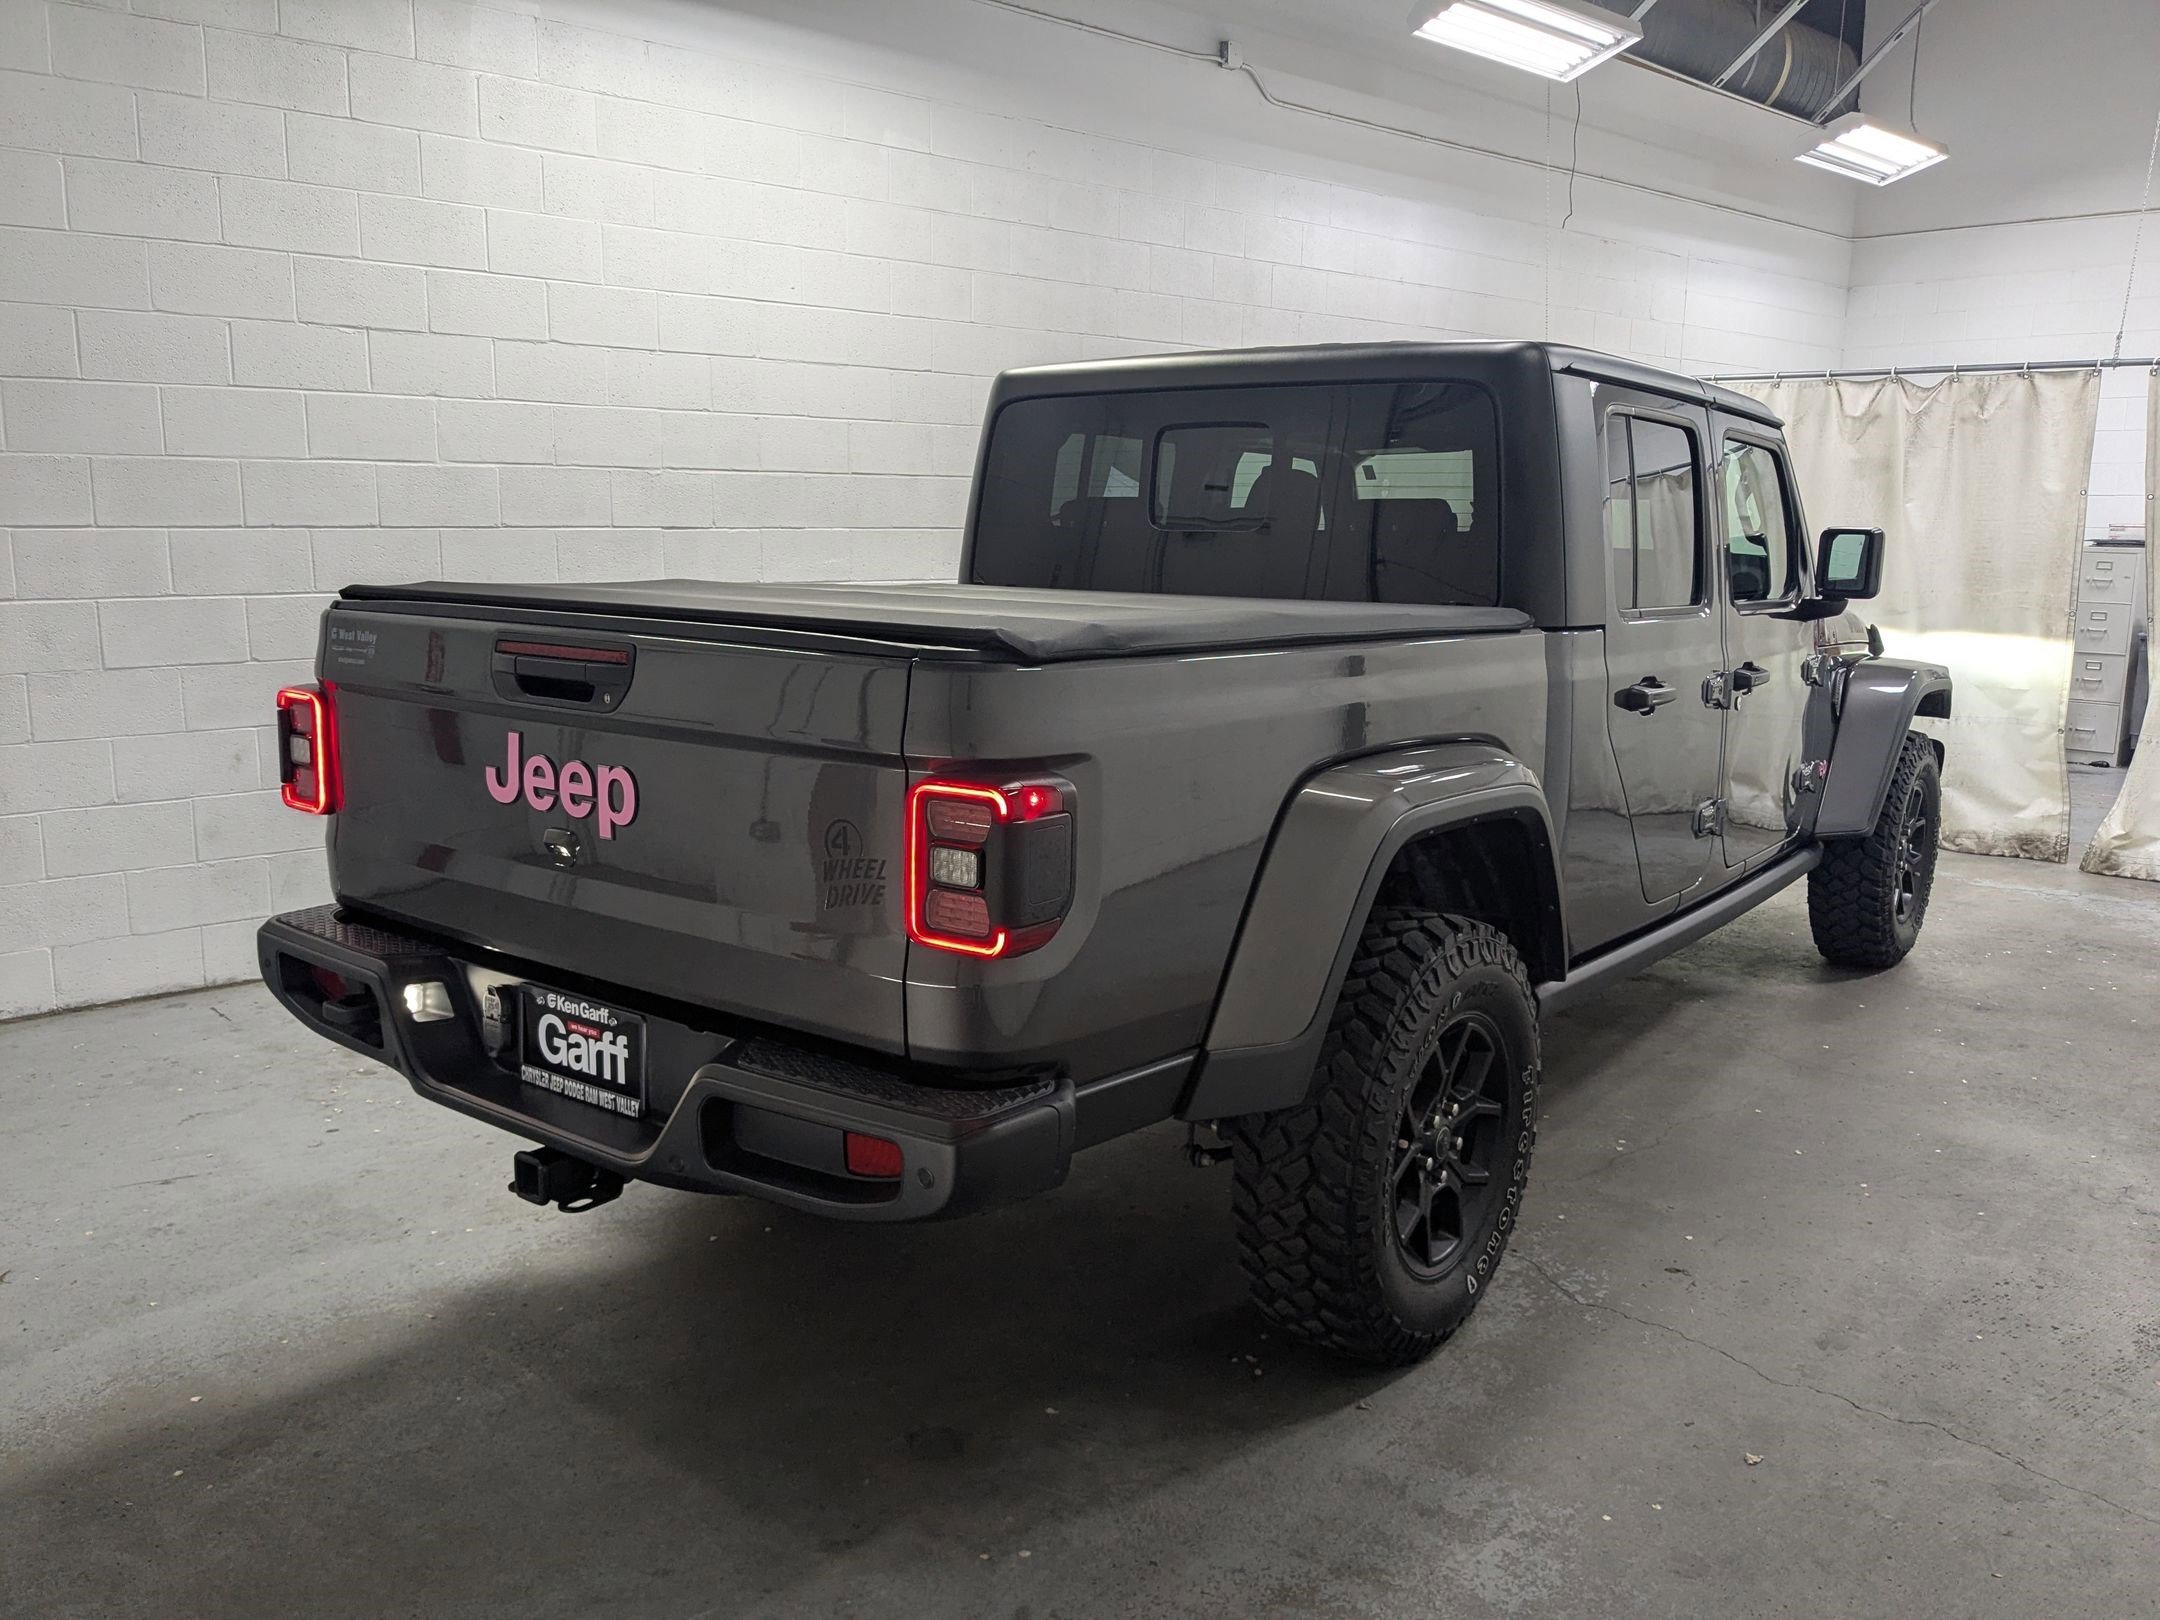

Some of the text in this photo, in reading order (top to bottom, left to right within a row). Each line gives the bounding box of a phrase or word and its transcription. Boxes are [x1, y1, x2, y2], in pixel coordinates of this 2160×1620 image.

[357, 630, 377, 645] Valley
[485, 731, 640, 841] Jeep
[823, 858, 887, 883] WHEEL
[824, 883, 887, 911] DRIVE
[538, 1013, 629, 1085] Garff
[521, 1065, 640, 1119] CHRYSLER JEEP DODGE RAM WEST VALLEY
